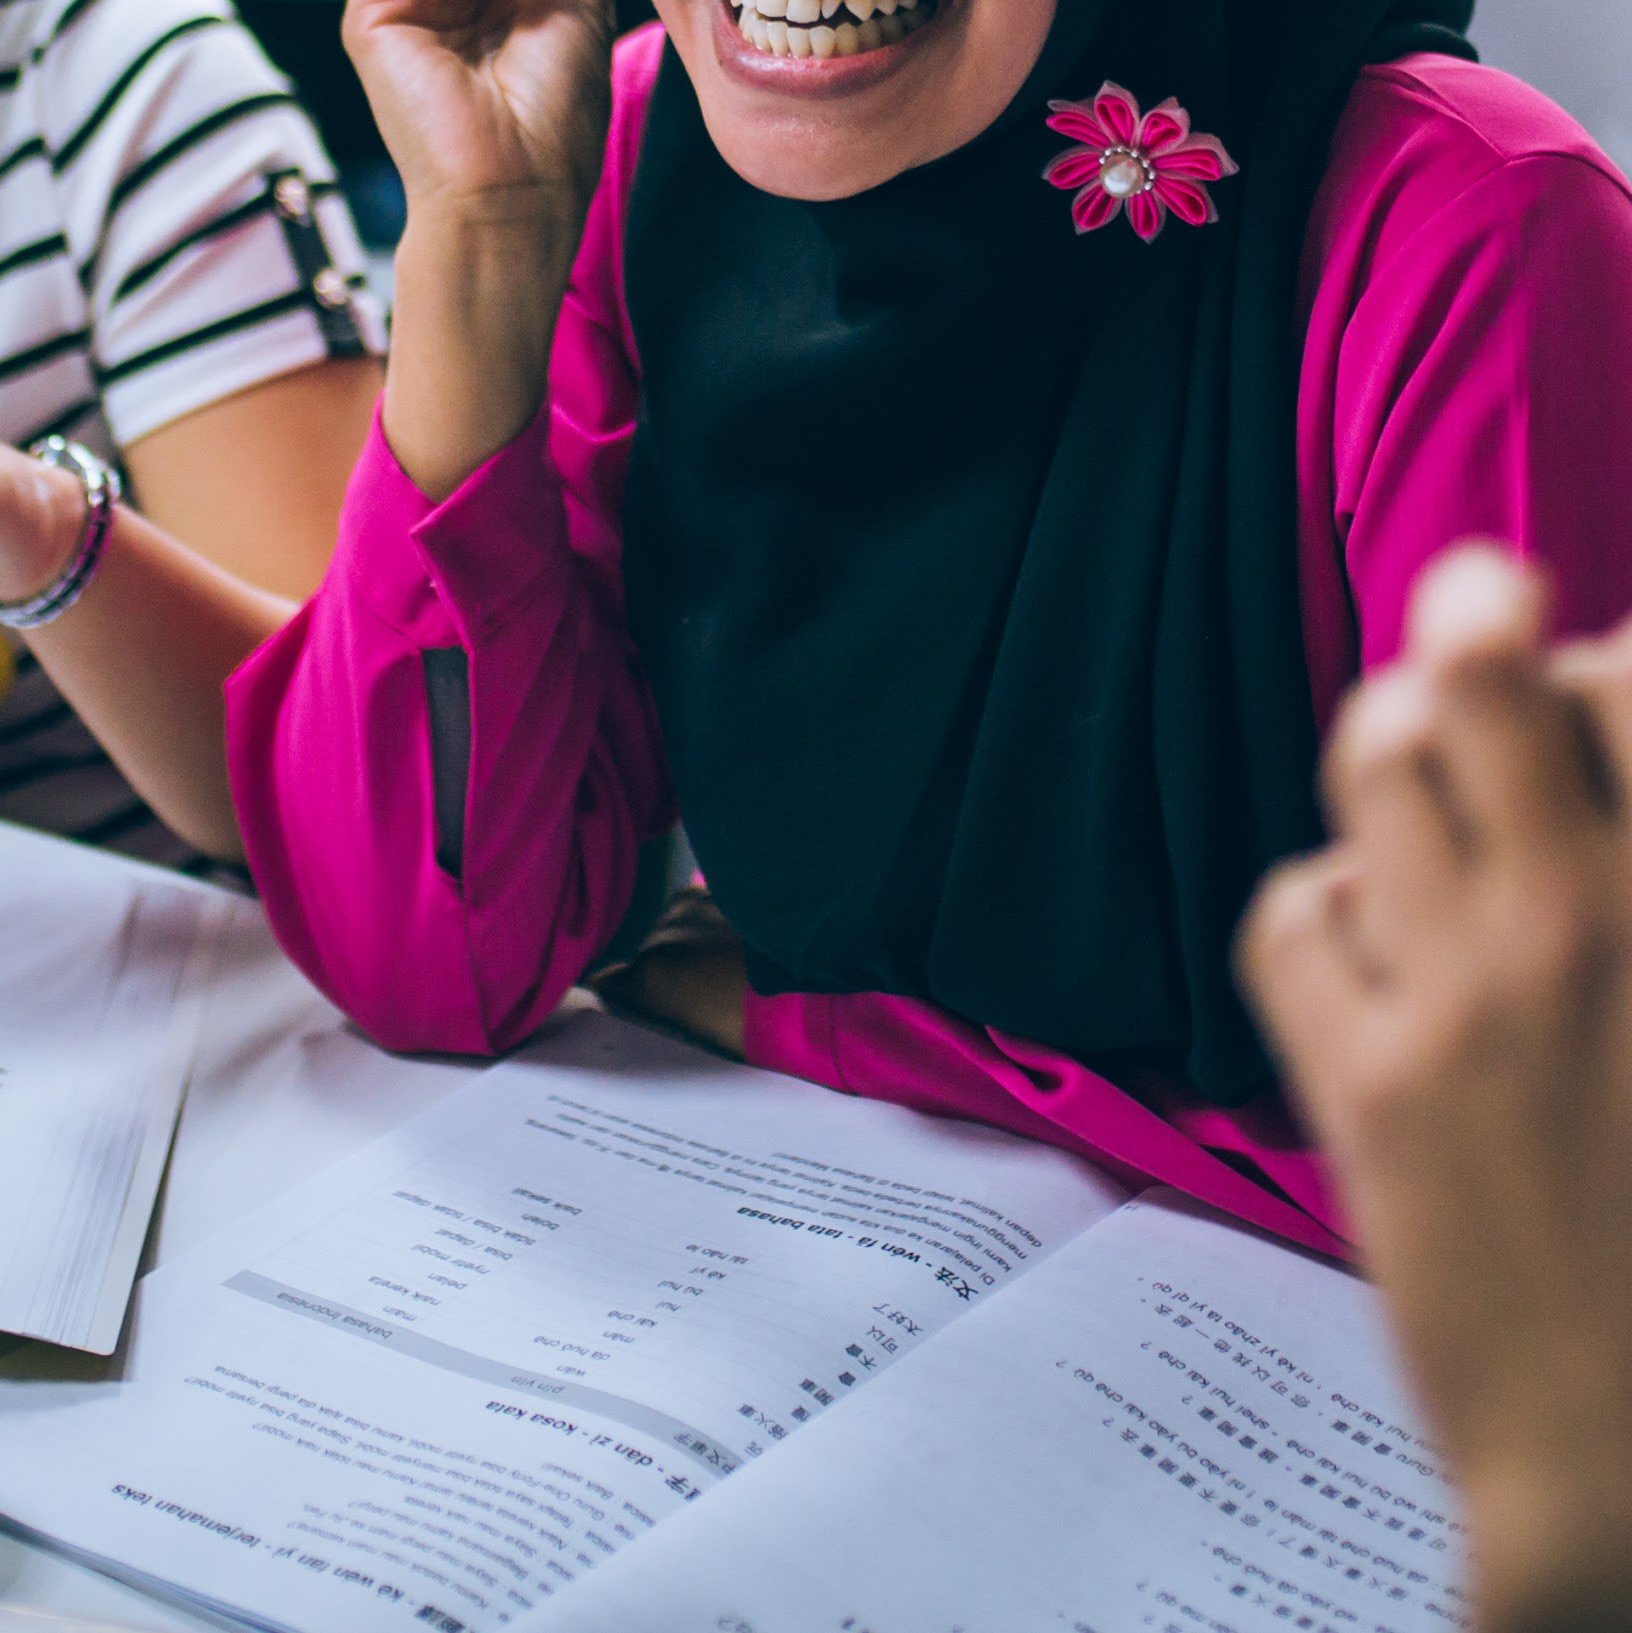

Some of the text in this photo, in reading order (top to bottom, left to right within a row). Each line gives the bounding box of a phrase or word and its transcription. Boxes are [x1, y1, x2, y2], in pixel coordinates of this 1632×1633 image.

[735, 1205, 805, 1231] bahasa
[806, 1223, 845, 1240] tata
[433, 1227, 515, 1262] bisa dapat
[951, 1229, 984, 1251] ingin
[1004, 1218, 1044, 1249] depan
[409, 1243, 491, 1276] nyetir mobil
[924, 1238, 984, 1274] pelajaran
[981, 1247, 1014, 1274] kami
[367, 1274, 442, 1307] naik kereta
[426, 1272, 470, 1291] pelan
[933, 1265, 980, 1303] 文法
[978, 1271, 997, 1287] Di
[275, 1291, 394, 1341] bahasa Indonesia
[381, 1304, 418, 1323] main
[871, 1302, 924, 1338] 太好了
[865, 1324, 900, 1356] 可以
[484, 1400, 529, 1421] kata
[528, 1412, 579, 1437] kosa
[110, 1483, 153, 1506] teks
[585, 1479, 615, 1502] Baik
[153, 1499, 262, 1549] terjemahan
